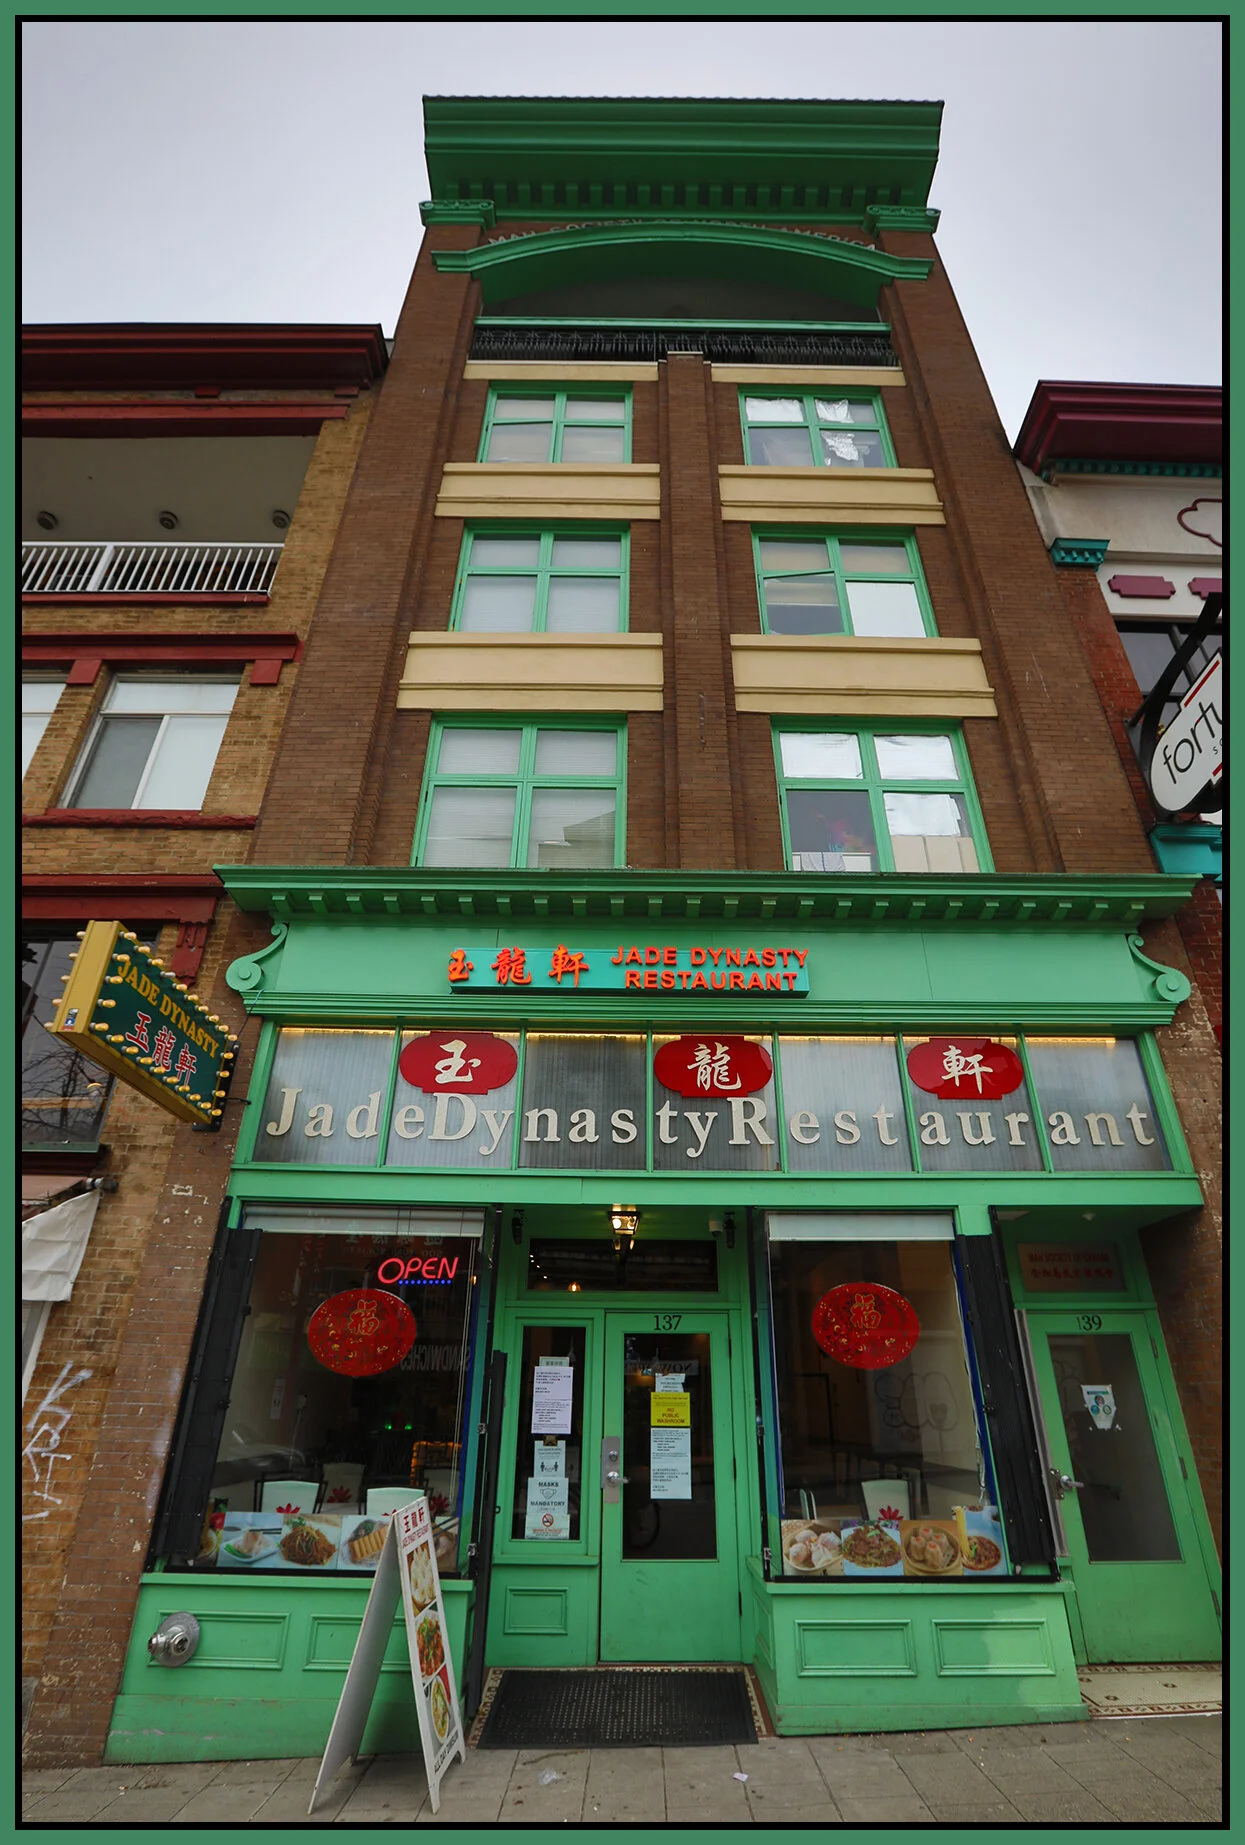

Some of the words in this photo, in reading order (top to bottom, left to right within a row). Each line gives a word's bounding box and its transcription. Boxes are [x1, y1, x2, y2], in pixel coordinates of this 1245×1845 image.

[447, 943, 590, 988] 玉龍軒
[611, 946, 677, 966] JADE
[690, 947, 809, 968] DYNASTY
[625, 970, 798, 991] RESTAURANT
[117, 959, 161, 1006] JADE
[160, 993, 220, 1059] DYNASTY
[125, 1010, 197, 1087] 玉龍軒
[434, 1039, 481, 1084] 玉
[687, 1041, 742, 1091] 龍
[941, 1044, 993, 1094] 軒
[378, 1256, 459, 1284] OPEN
[653, 1315, 682, 1331] 137
